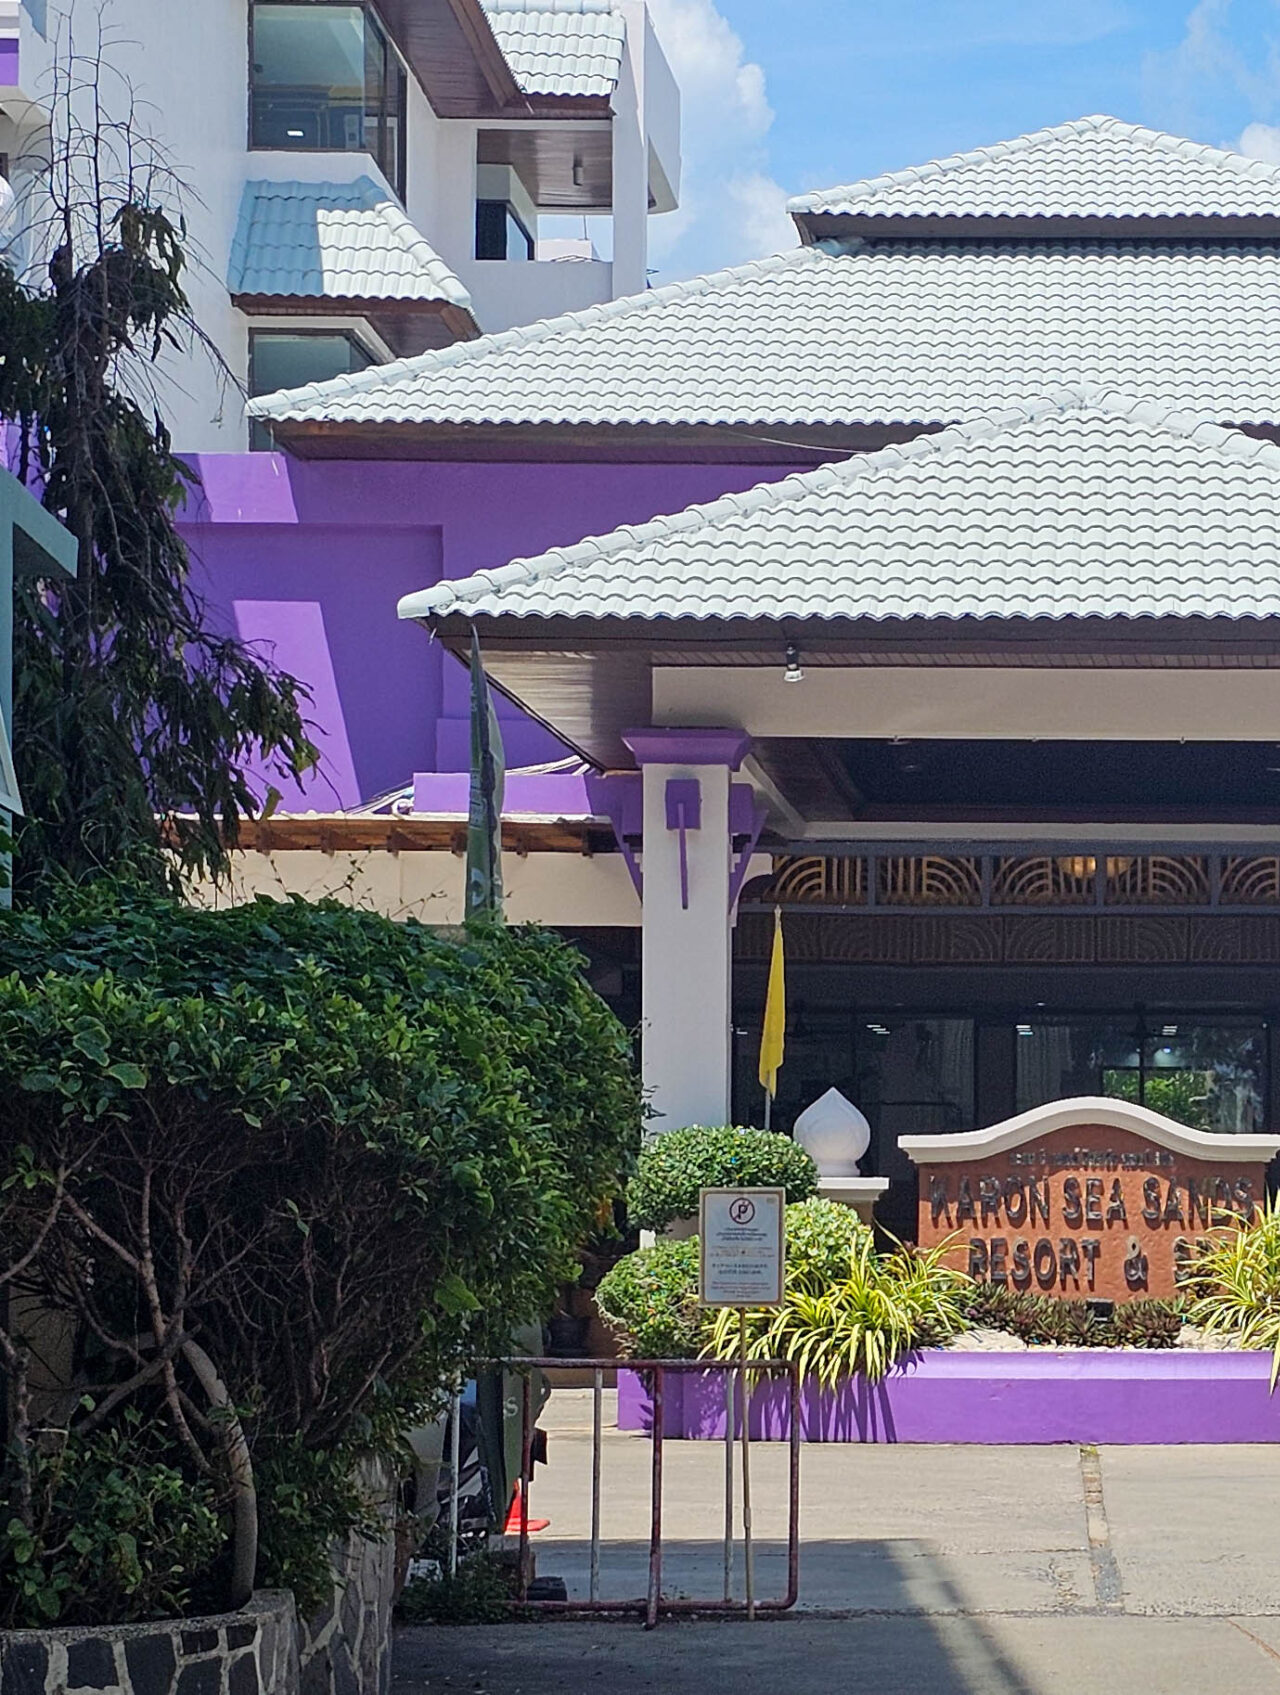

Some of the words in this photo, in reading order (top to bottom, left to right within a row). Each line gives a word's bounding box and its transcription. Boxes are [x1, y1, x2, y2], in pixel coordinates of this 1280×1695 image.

[929, 1175, 1049, 1219] KARON
[1062, 1175, 1126, 1219] SEA
[1141, 1175, 1254, 1220] SANDS
[969, 1237, 1101, 1281] RESORT
[1124, 1234, 1148, 1281] &
